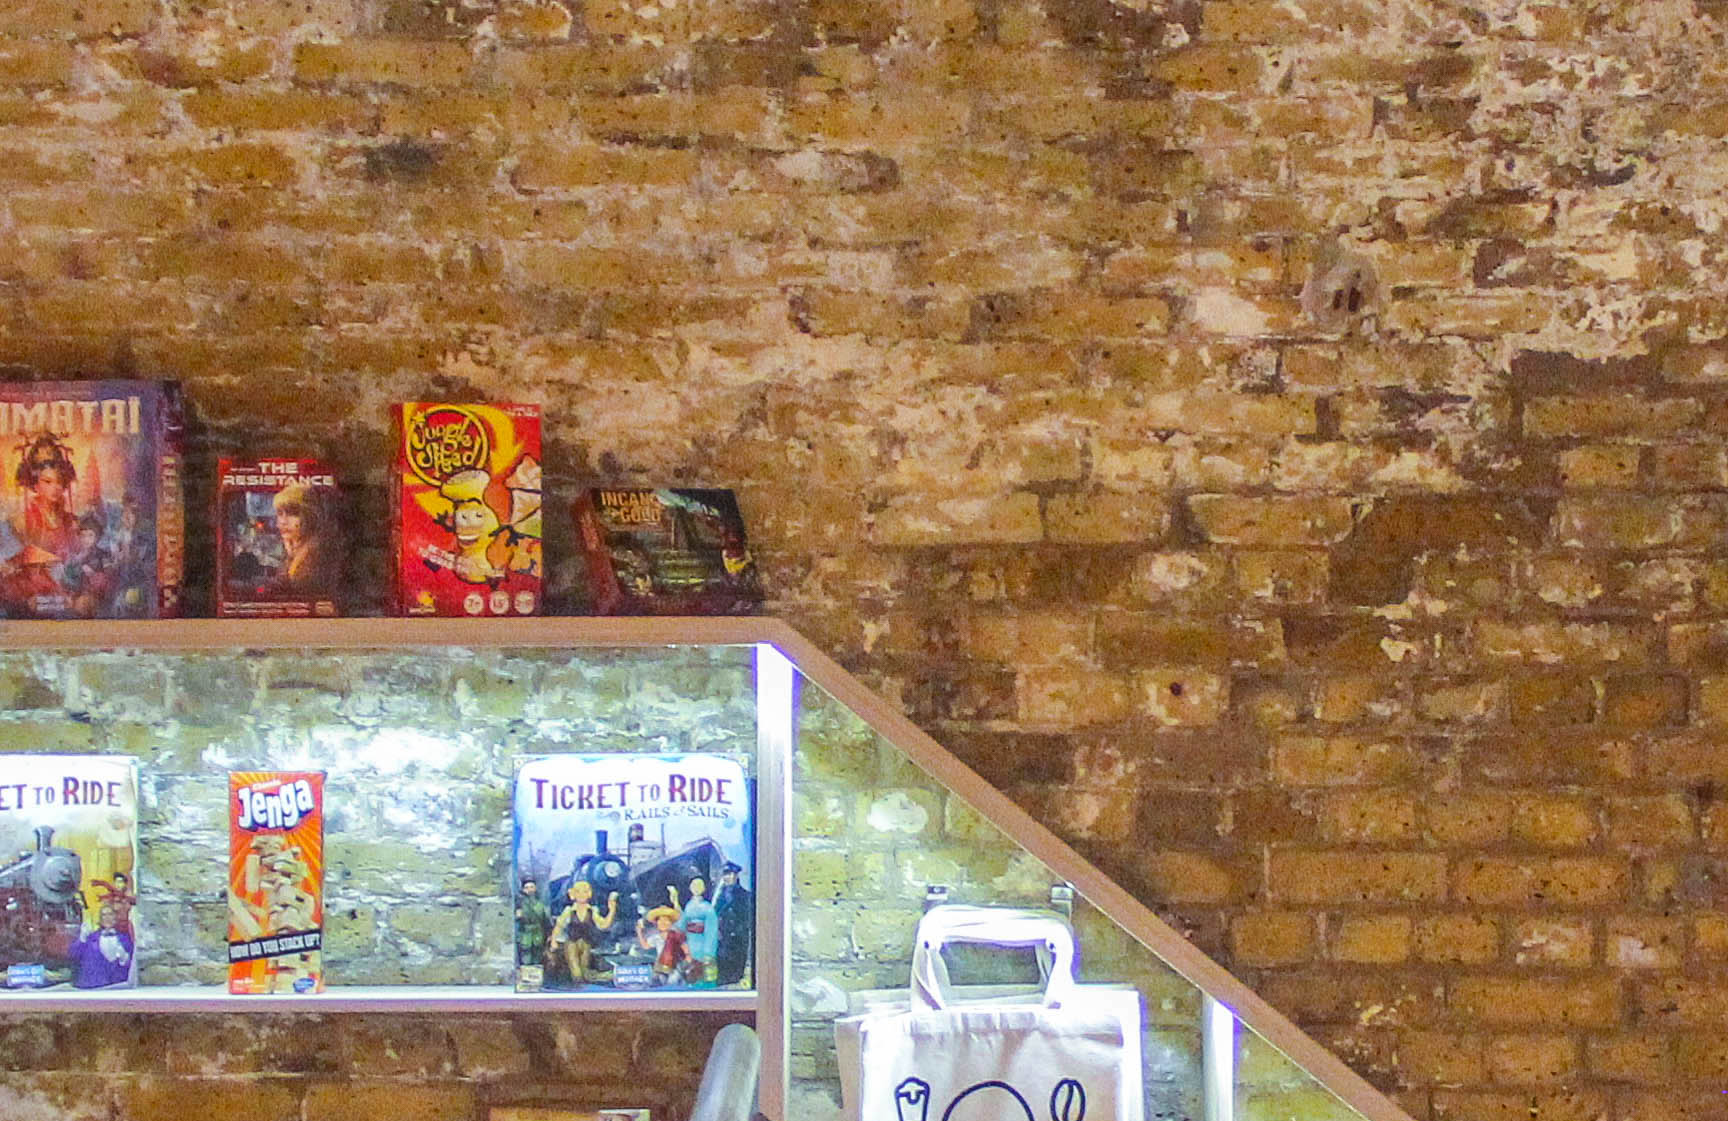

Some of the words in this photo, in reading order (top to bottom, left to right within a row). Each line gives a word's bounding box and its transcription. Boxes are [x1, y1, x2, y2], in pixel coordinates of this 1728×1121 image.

[258, 462, 299, 474] THE
[222, 475, 334, 486] RESISTANCE
[34, 785, 56, 806] TO
[62, 776, 122, 808] RIDE
[529, 777, 631, 811] TICKET
[638, 783, 661, 803] TO
[668, 773, 733, 806] RIDE
[237, 779, 315, 830] Jenga
[624, 805, 671, 821] RAILS
[687, 805, 730, 820] SAILS
